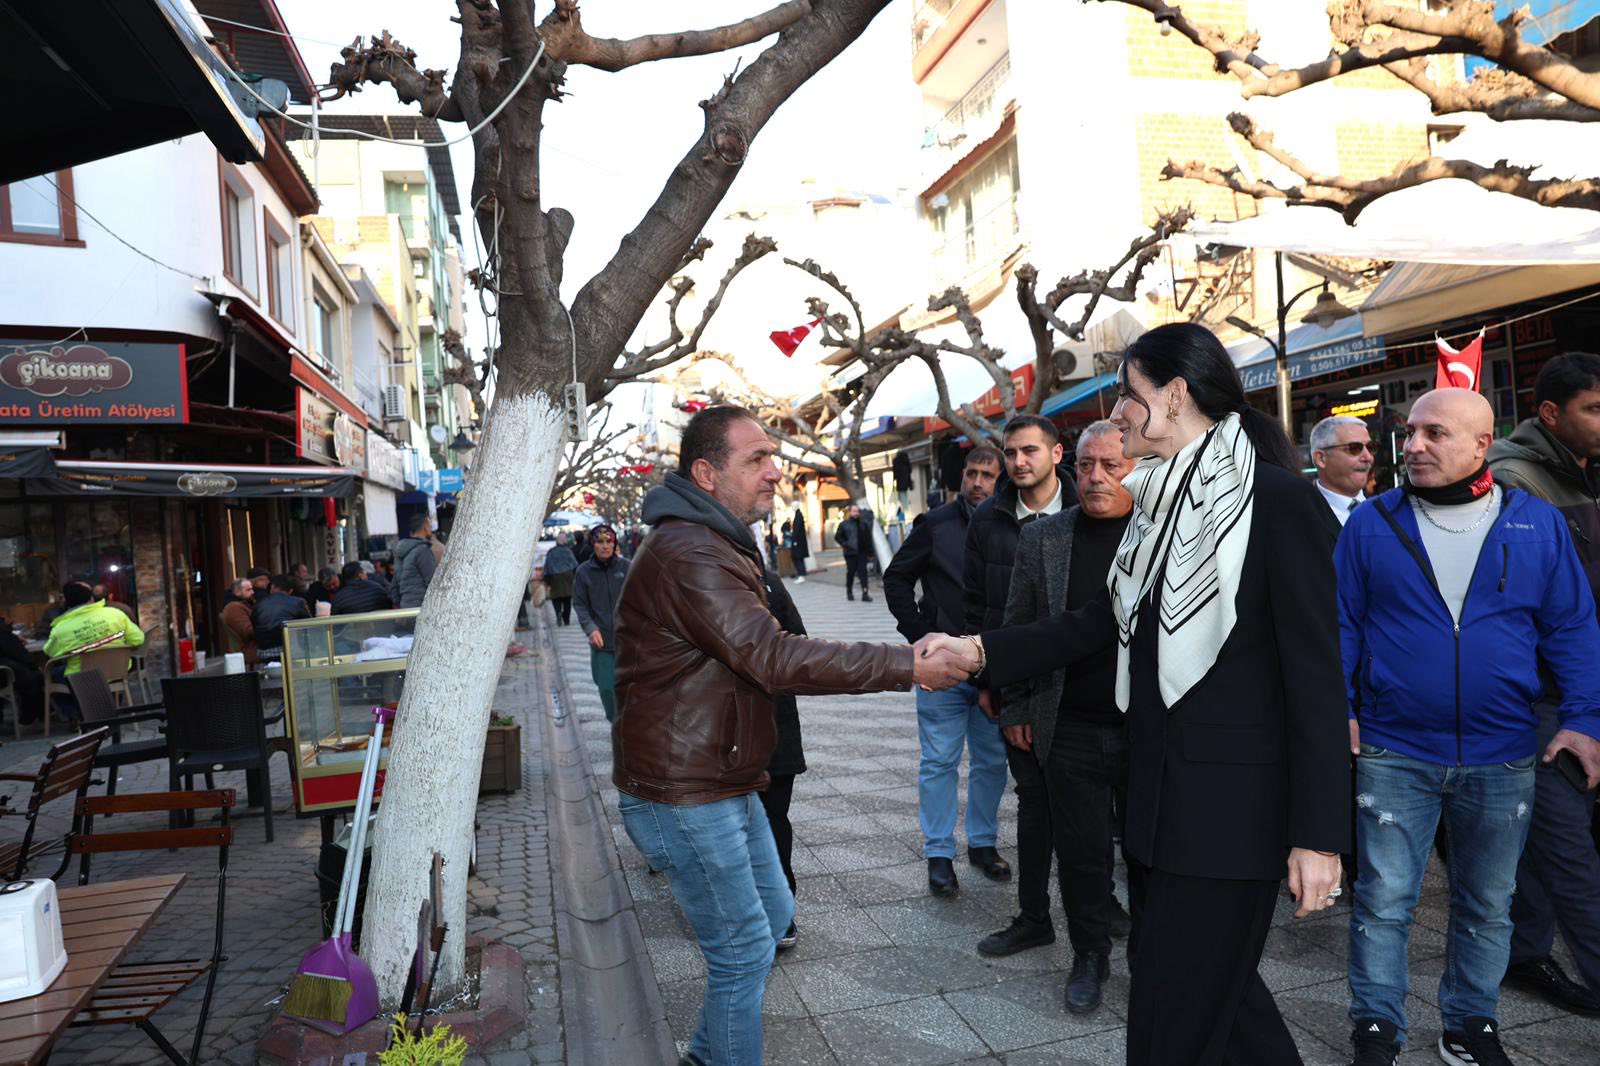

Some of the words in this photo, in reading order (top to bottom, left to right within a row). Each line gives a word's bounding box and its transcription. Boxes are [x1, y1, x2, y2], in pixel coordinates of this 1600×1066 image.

[19, 356, 112, 385] çikoana
[38, 400, 102, 418] Üretim
[108, 402, 176, 420] Atölyesi
[326, 528, 336, 565] AVUZ
